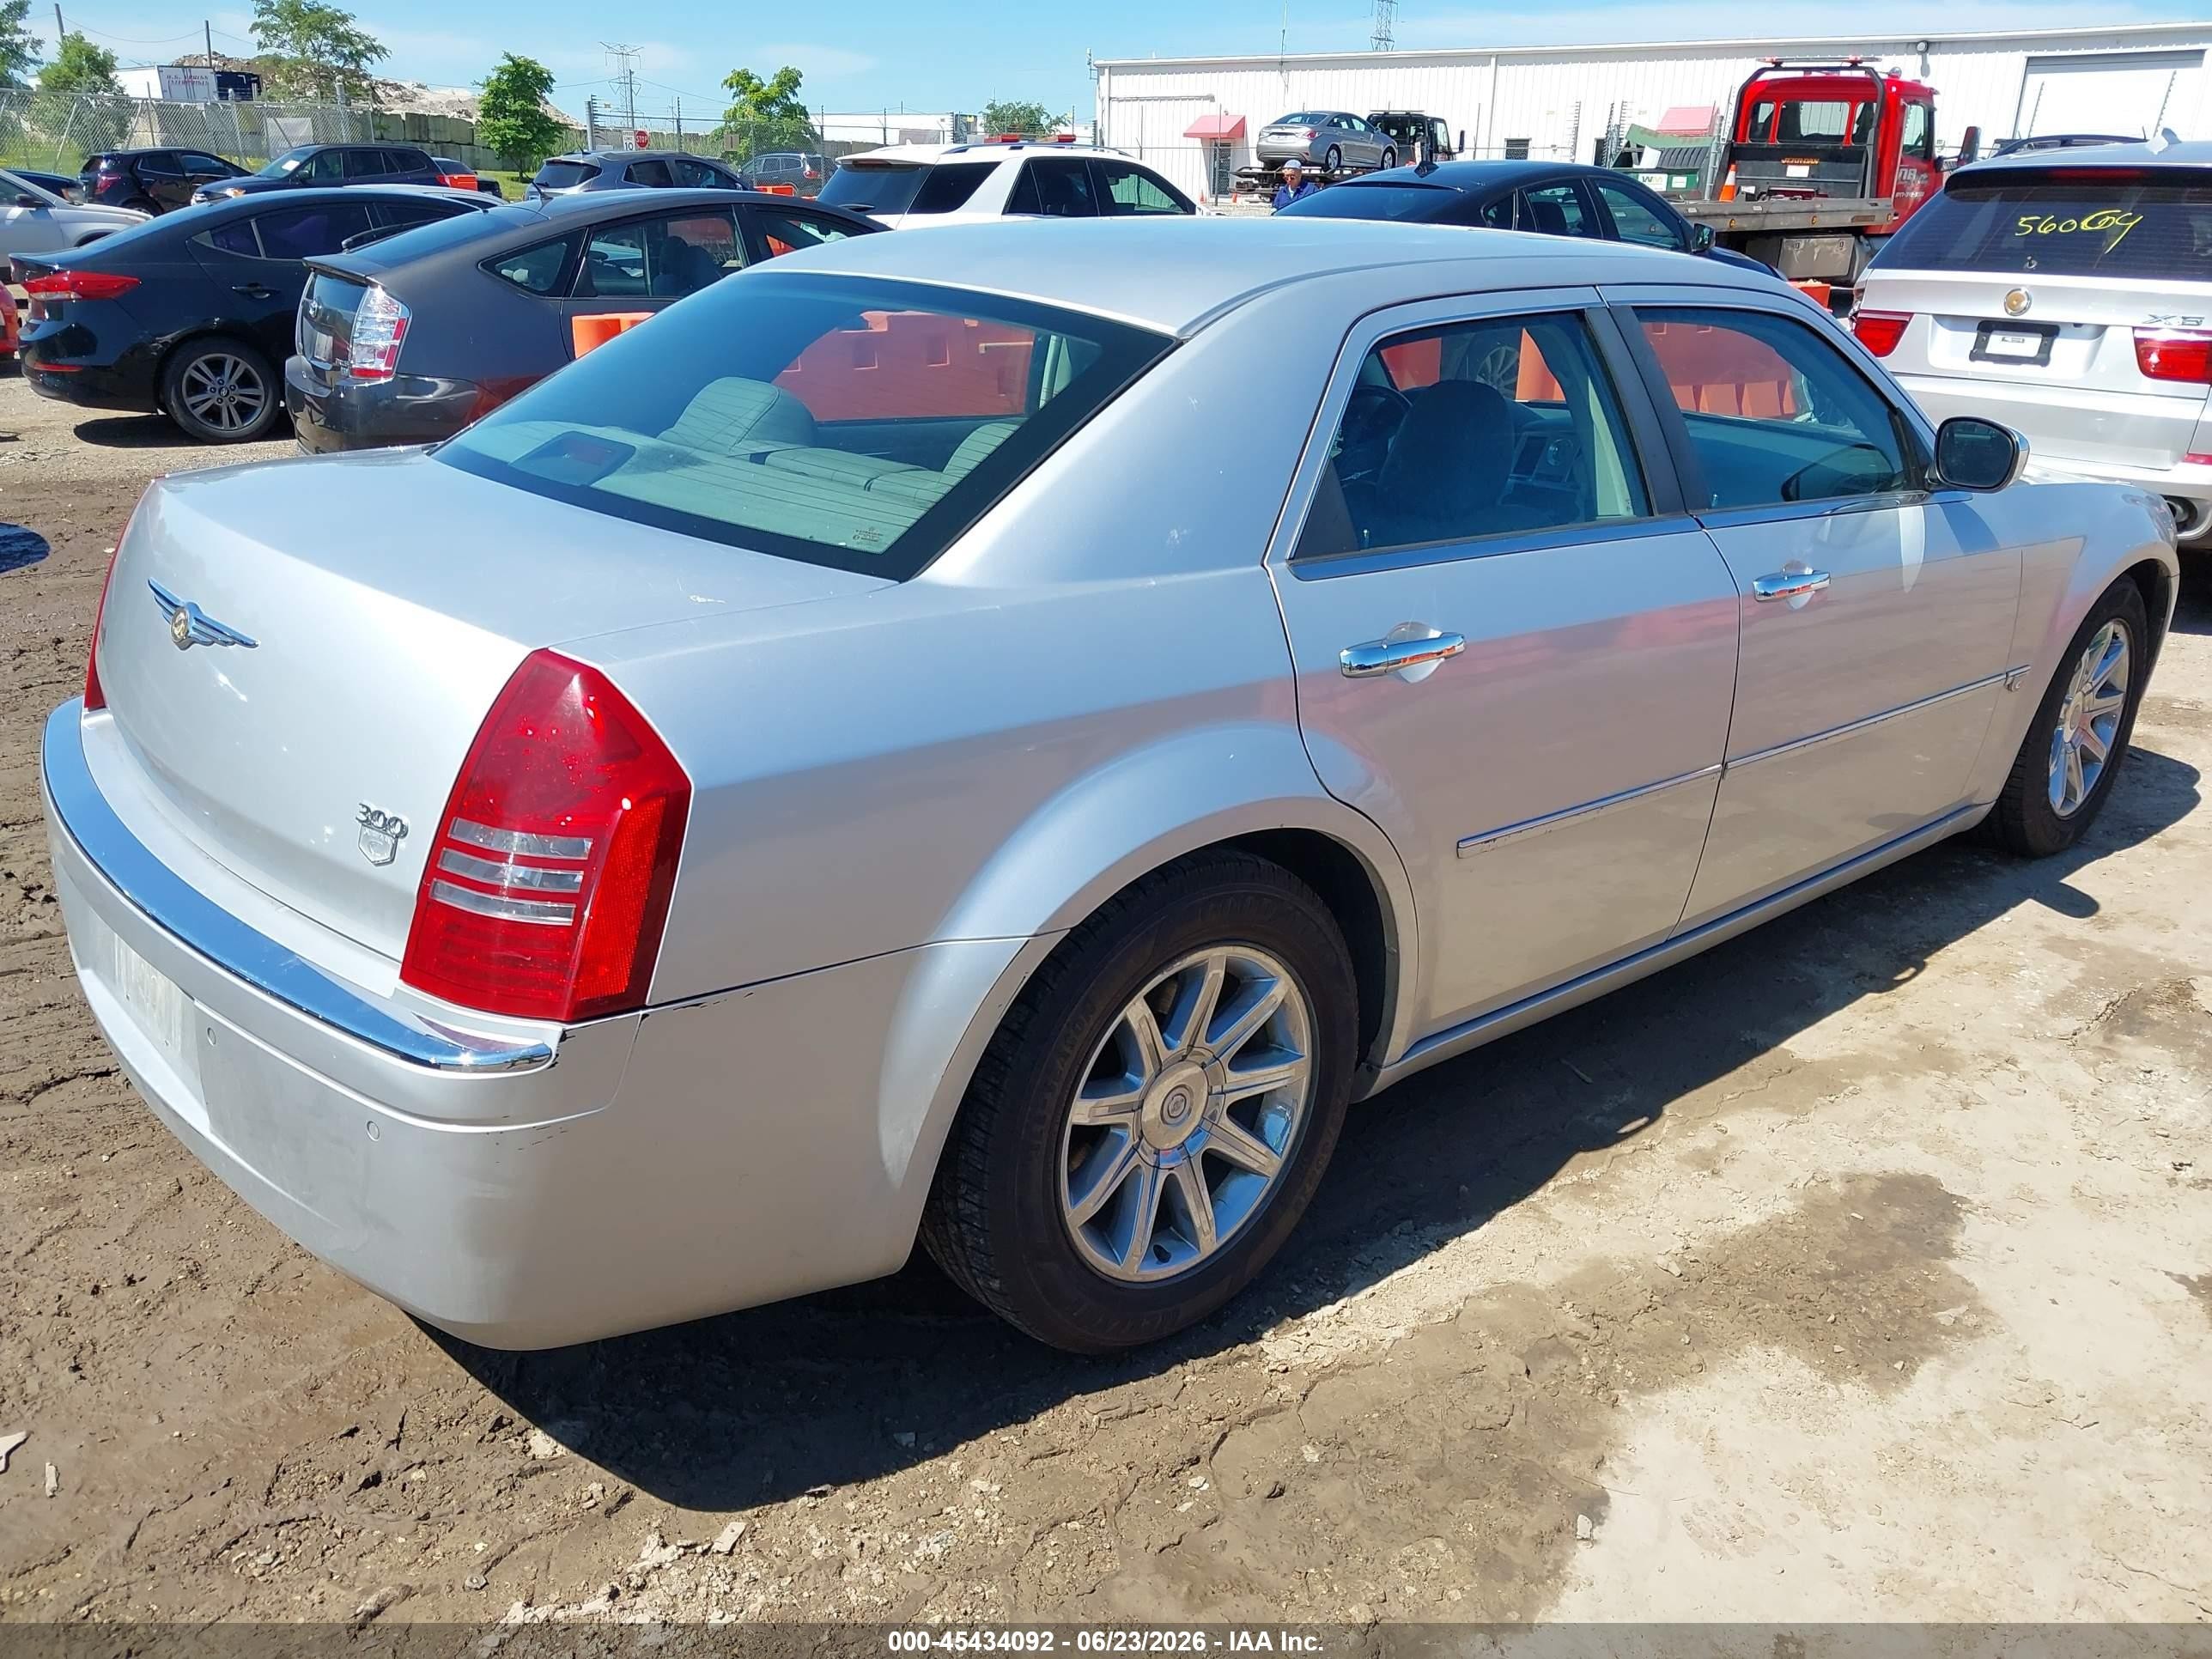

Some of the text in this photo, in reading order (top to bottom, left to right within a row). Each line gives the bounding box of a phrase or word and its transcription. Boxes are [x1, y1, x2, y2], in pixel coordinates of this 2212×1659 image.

[636, 135, 647, 143] STOP
[624, 142, 634, 151] 10
[2142, 313, 2206, 327] X5
[356, 803, 410, 840] 300
